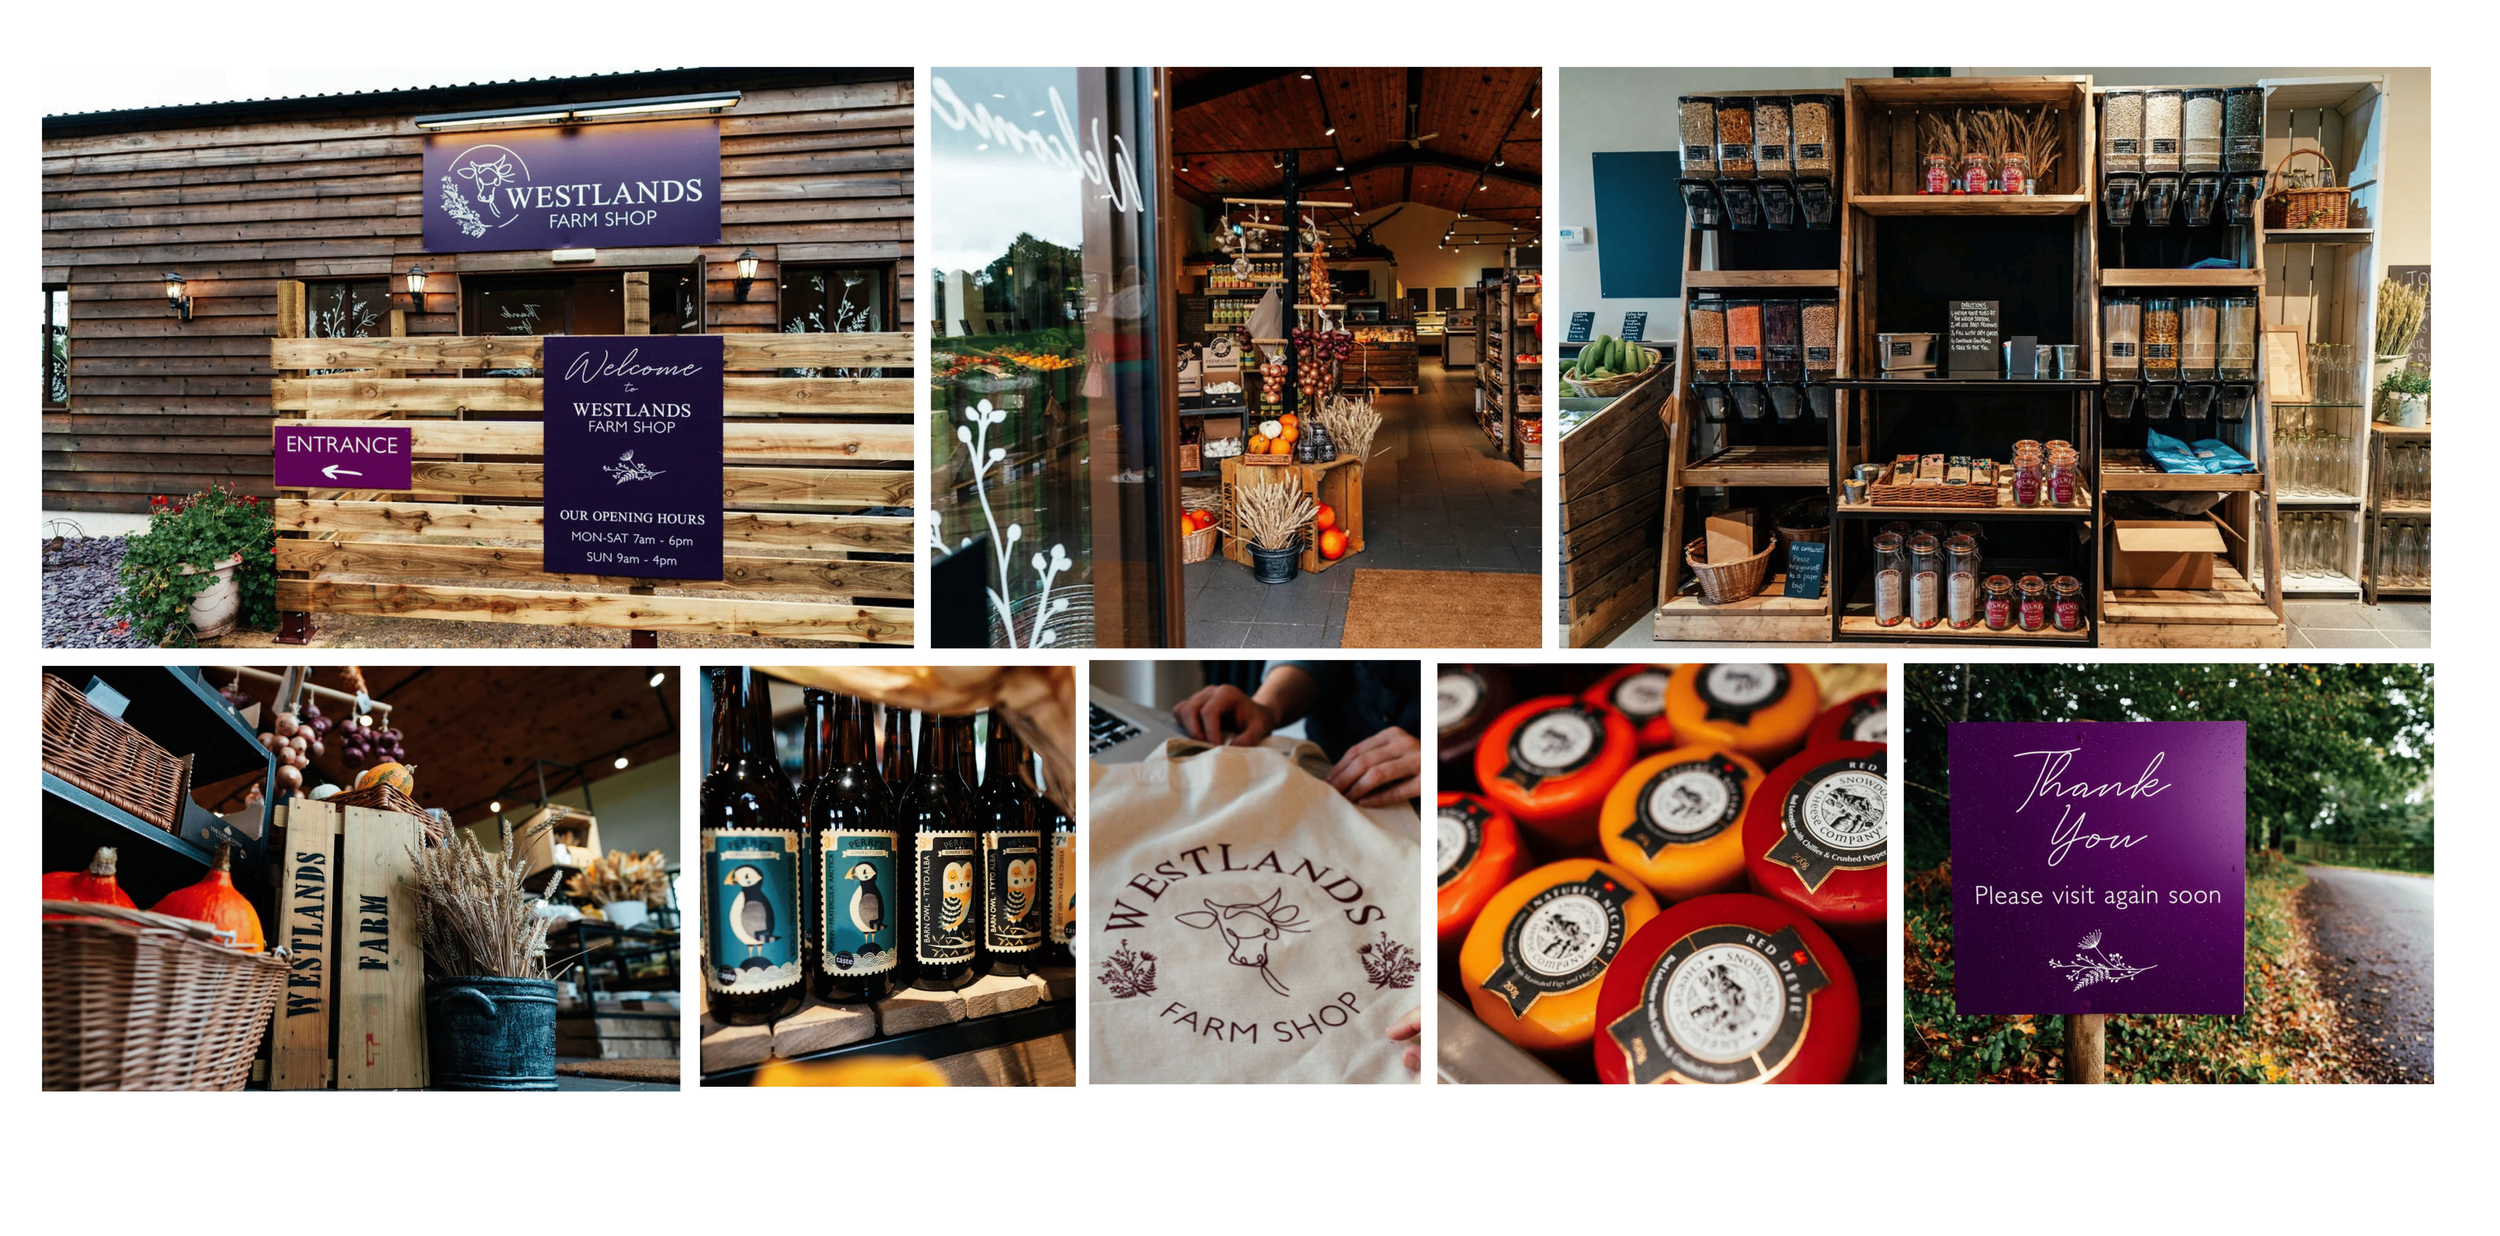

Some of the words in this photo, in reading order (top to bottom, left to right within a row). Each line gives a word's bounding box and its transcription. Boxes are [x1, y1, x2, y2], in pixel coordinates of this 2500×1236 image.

[505, 178, 703, 209] WESTLANDS
[549, 212, 598, 229] FARM
[604, 210, 658, 227] SHOP
[564, 348, 703, 384] Welcome
[624, 382, 639, 393] to
[573, 402, 692, 418] WESTLANDS
[588, 420, 628, 433] FARM
[633, 420, 676, 434] SHOP
[286, 435, 398, 454] ENTRANCE
[560, 509, 589, 521] OUR
[592, 510, 653, 524] OPENING
[657, 513, 706, 526] HOURS
[571, 531, 629, 544] MON-SAT
[633, 534, 656, 545] 7am
[668, 535, 694, 548] 6pm
[586, 551, 613, 563] SUN
[616, 552, 640, 564] 9am
[652, 555, 677, 568] 4pm
[1849, 761, 1878, 772] RED
[1839, 776, 1887, 803] SNOWDO
[2014, 747, 2172, 813] Thank
[848, 838, 885, 849] PERRY'S
[2047, 804, 2148, 867] You
[1802, 840, 1823, 856] Chillies
[1831, 853, 1862, 863] Crushed
[1104, 843, 1387, 934] WESTLANDS
[1533, 886, 1601, 907] NATURE'S
[1975, 885, 2043, 905] Please
[2052, 885, 2095, 905] visit
[2104, 885, 2158, 910] again
[2169, 890, 2221, 904] soon
[923, 904, 931, 921] OWL
[989, 897, 997, 913] OWL
[358, 894, 389, 971] FARM
[989, 914, 997, 932] BARN
[286, 852, 326, 1018] WESTLANDS
[923, 923, 931, 943] BARN
[1745, 933, 1777, 956] RED
[836, 957, 853, 965] taste
[1160, 1001, 1259, 1044] FARM
[1273, 991, 1361, 1043] SHOP
